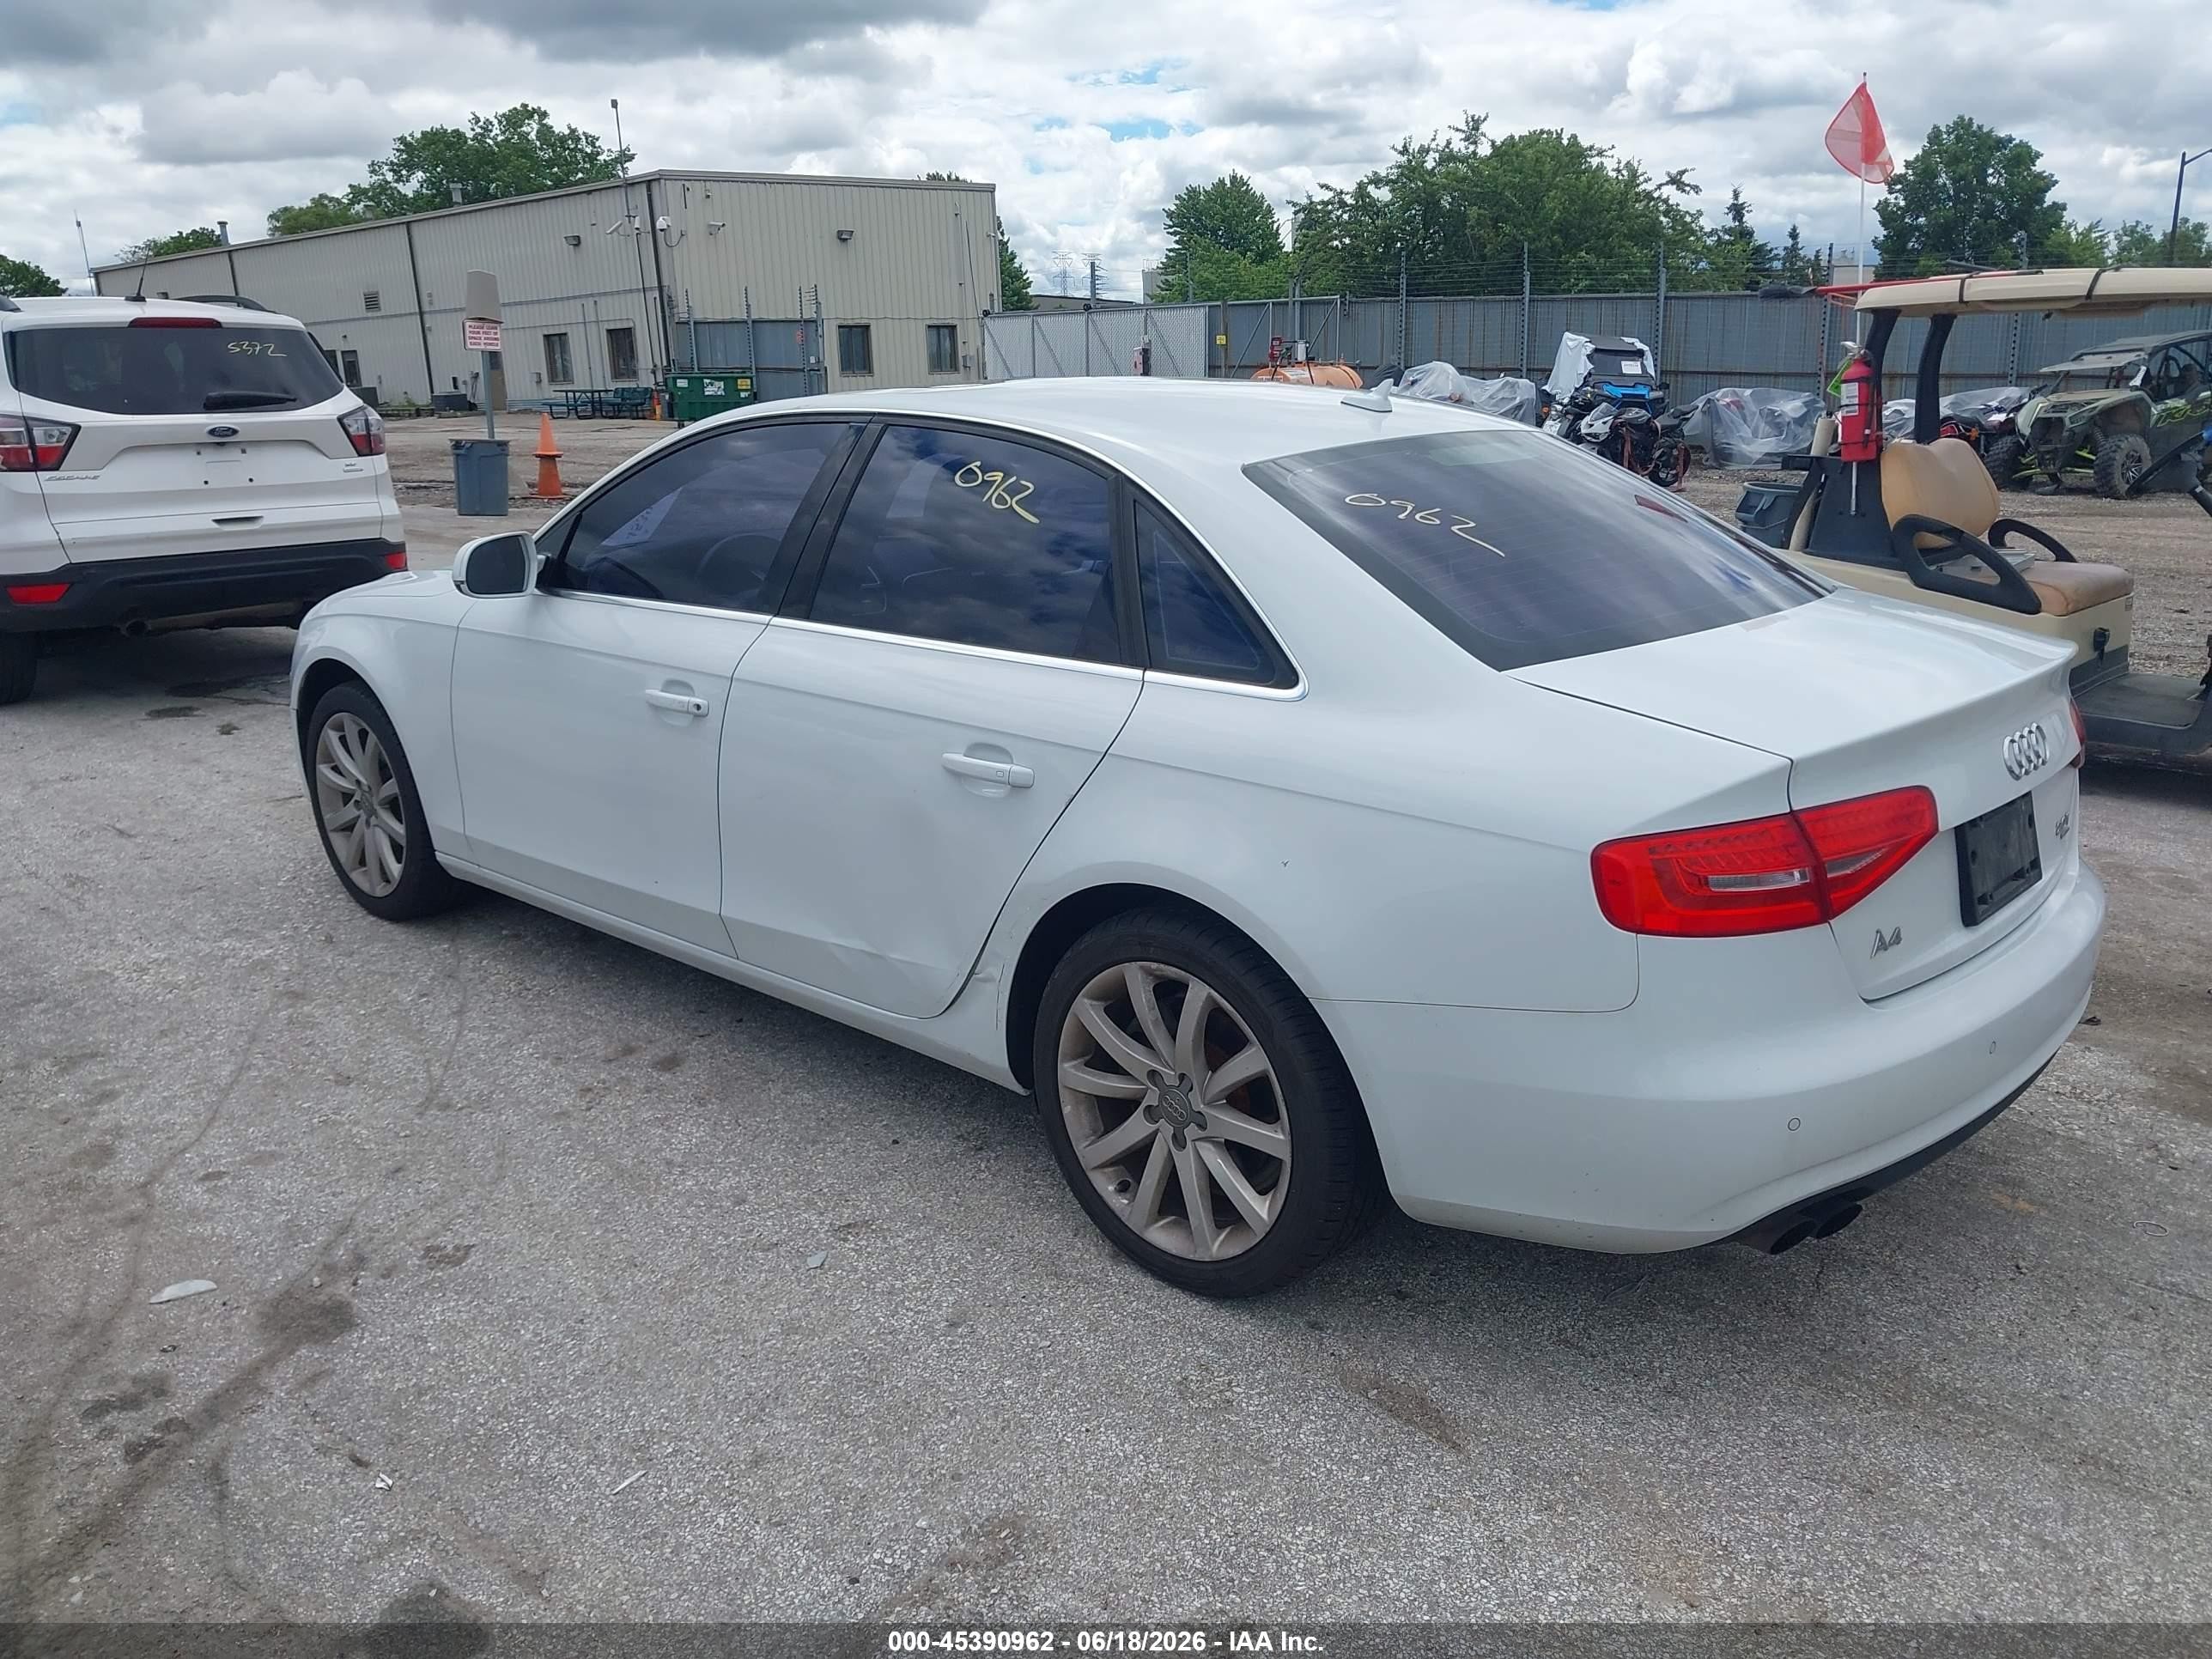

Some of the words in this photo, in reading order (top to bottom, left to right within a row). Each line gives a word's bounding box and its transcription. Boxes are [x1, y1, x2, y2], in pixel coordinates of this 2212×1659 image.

[227, 341, 289, 357] 5372
[954, 460, 1041, 524] 0962
[1344, 493, 1506, 558] 0962
[1870, 927, 1903, 958] A4
